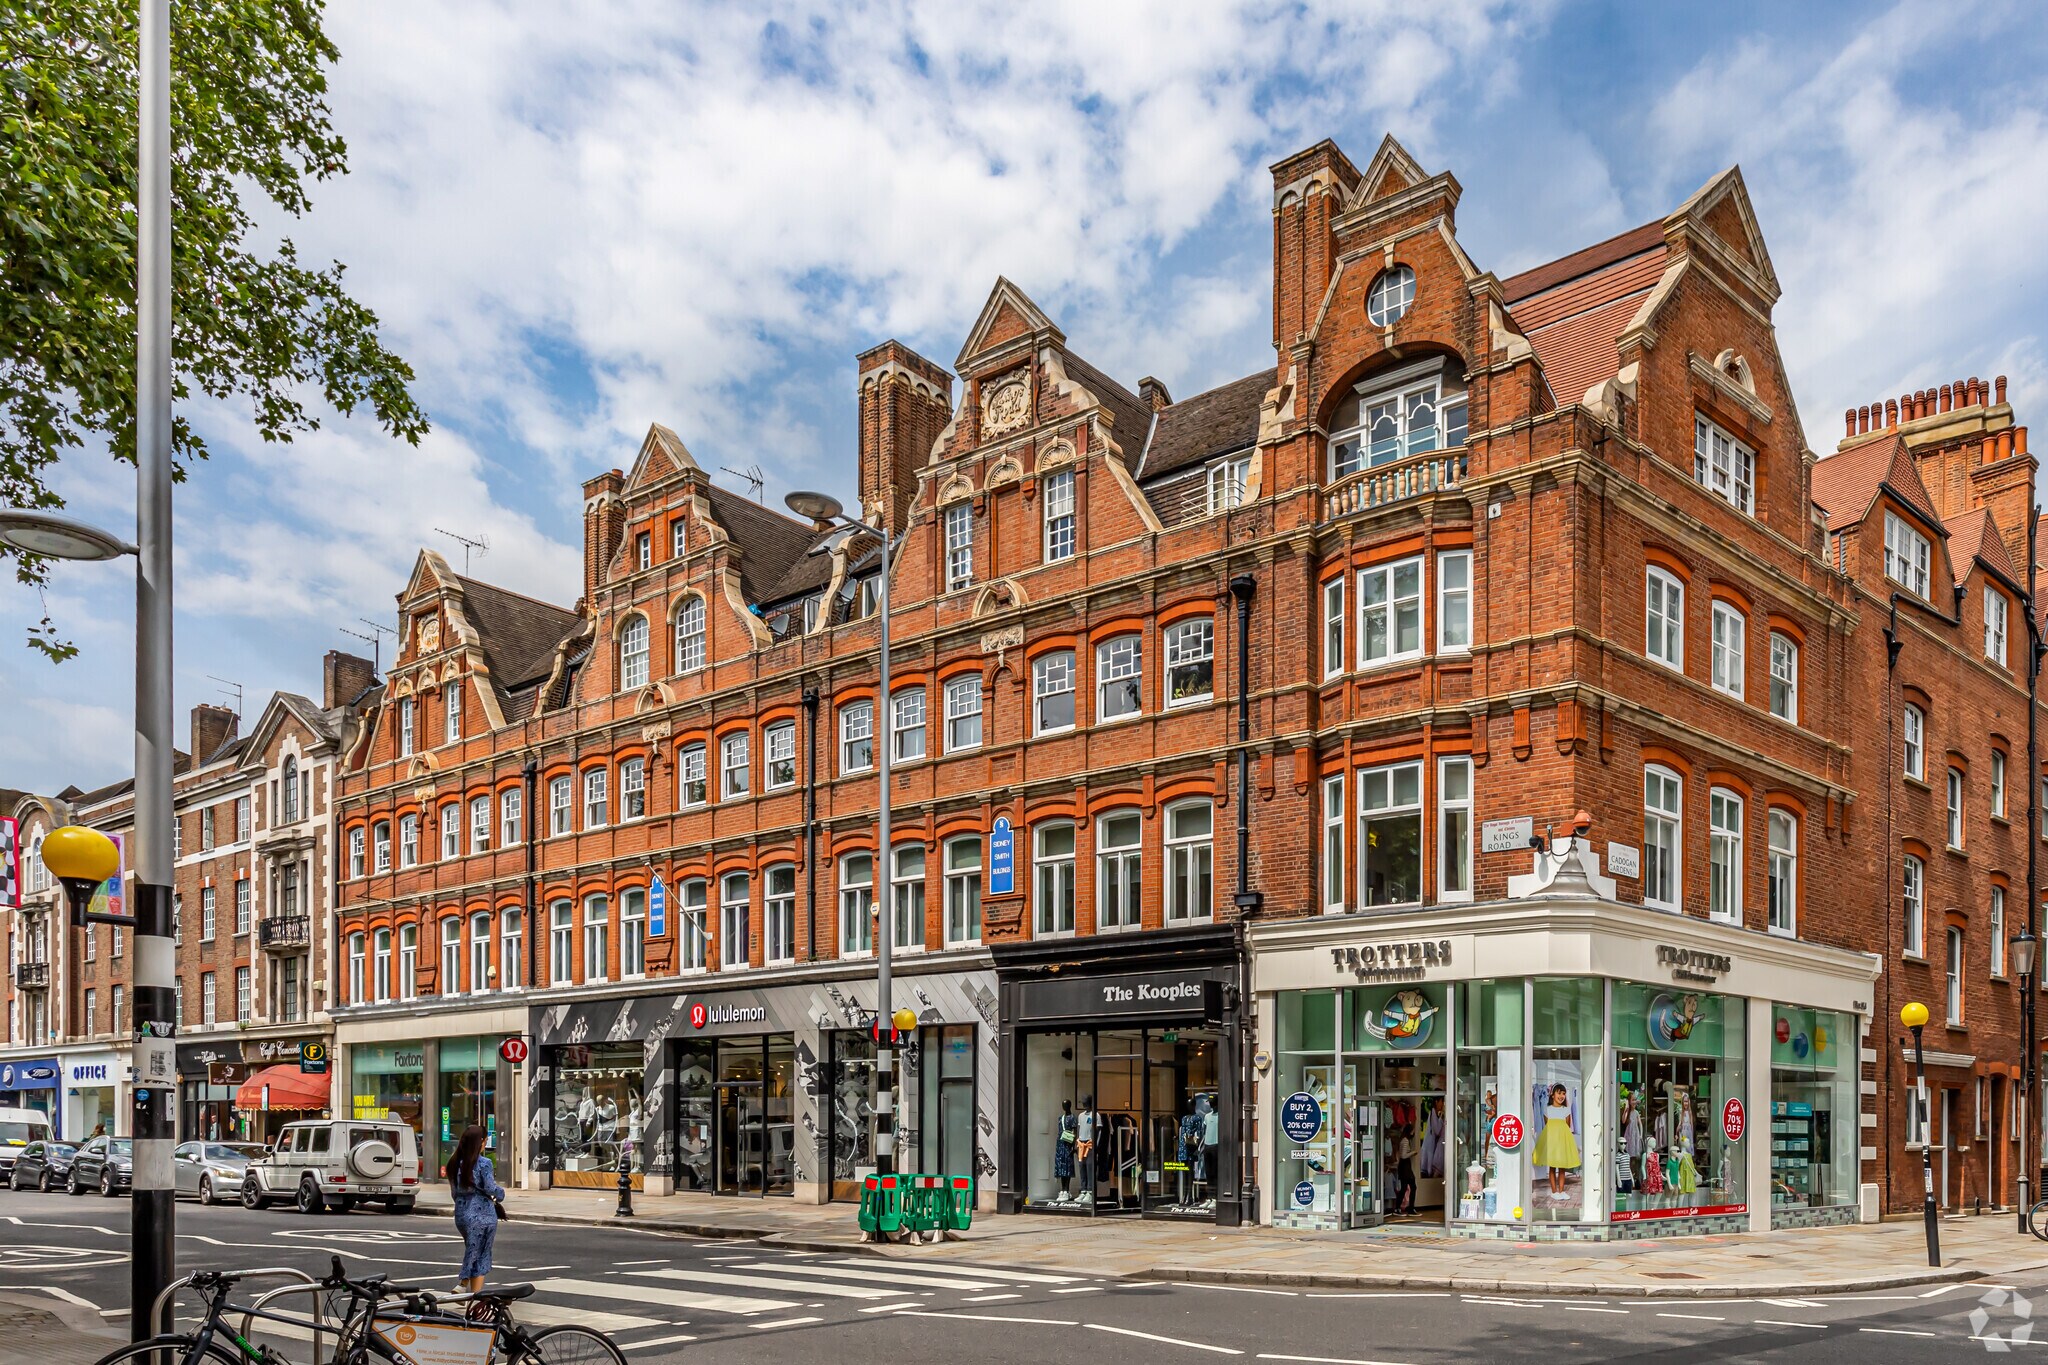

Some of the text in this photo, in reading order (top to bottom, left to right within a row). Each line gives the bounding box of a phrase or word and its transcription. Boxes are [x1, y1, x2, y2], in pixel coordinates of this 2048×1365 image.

[1493, 831, 1520, 841] KINGS
[993, 839, 1010, 848] SIDNEY
[1487, 841, 1512, 851] ROAD
[994, 852, 1010, 861] SMITH
[1611, 855, 1637, 868] CADOGAN
[1609, 863, 1633, 876] GARDENS
[1331, 940, 1451, 966] TROTTERS
[1655, 945, 1731, 972] TROTTERS
[1103, 982, 1201, 1002] The Kooples
[708, 1004, 765, 1023] lululemon
[73, 1065, 107, 1080] OFFICE
[353, 1095, 363, 1107] YOU
[1290, 1103, 1313, 1112] BUY 2,
[1729, 1103, 1740, 1113] Sale
[1287, 1121, 1301, 1129] 20%
[1500, 1118, 1516, 1126] Sale
[1727, 1115, 1741, 1125] 70%
[1499, 1127, 1518, 1135] 70%
[1726, 1124, 1741, 1134] OFF
[1630, 1211, 1641, 1220] Sale
[1689, 1208, 1699, 1216] Sale
